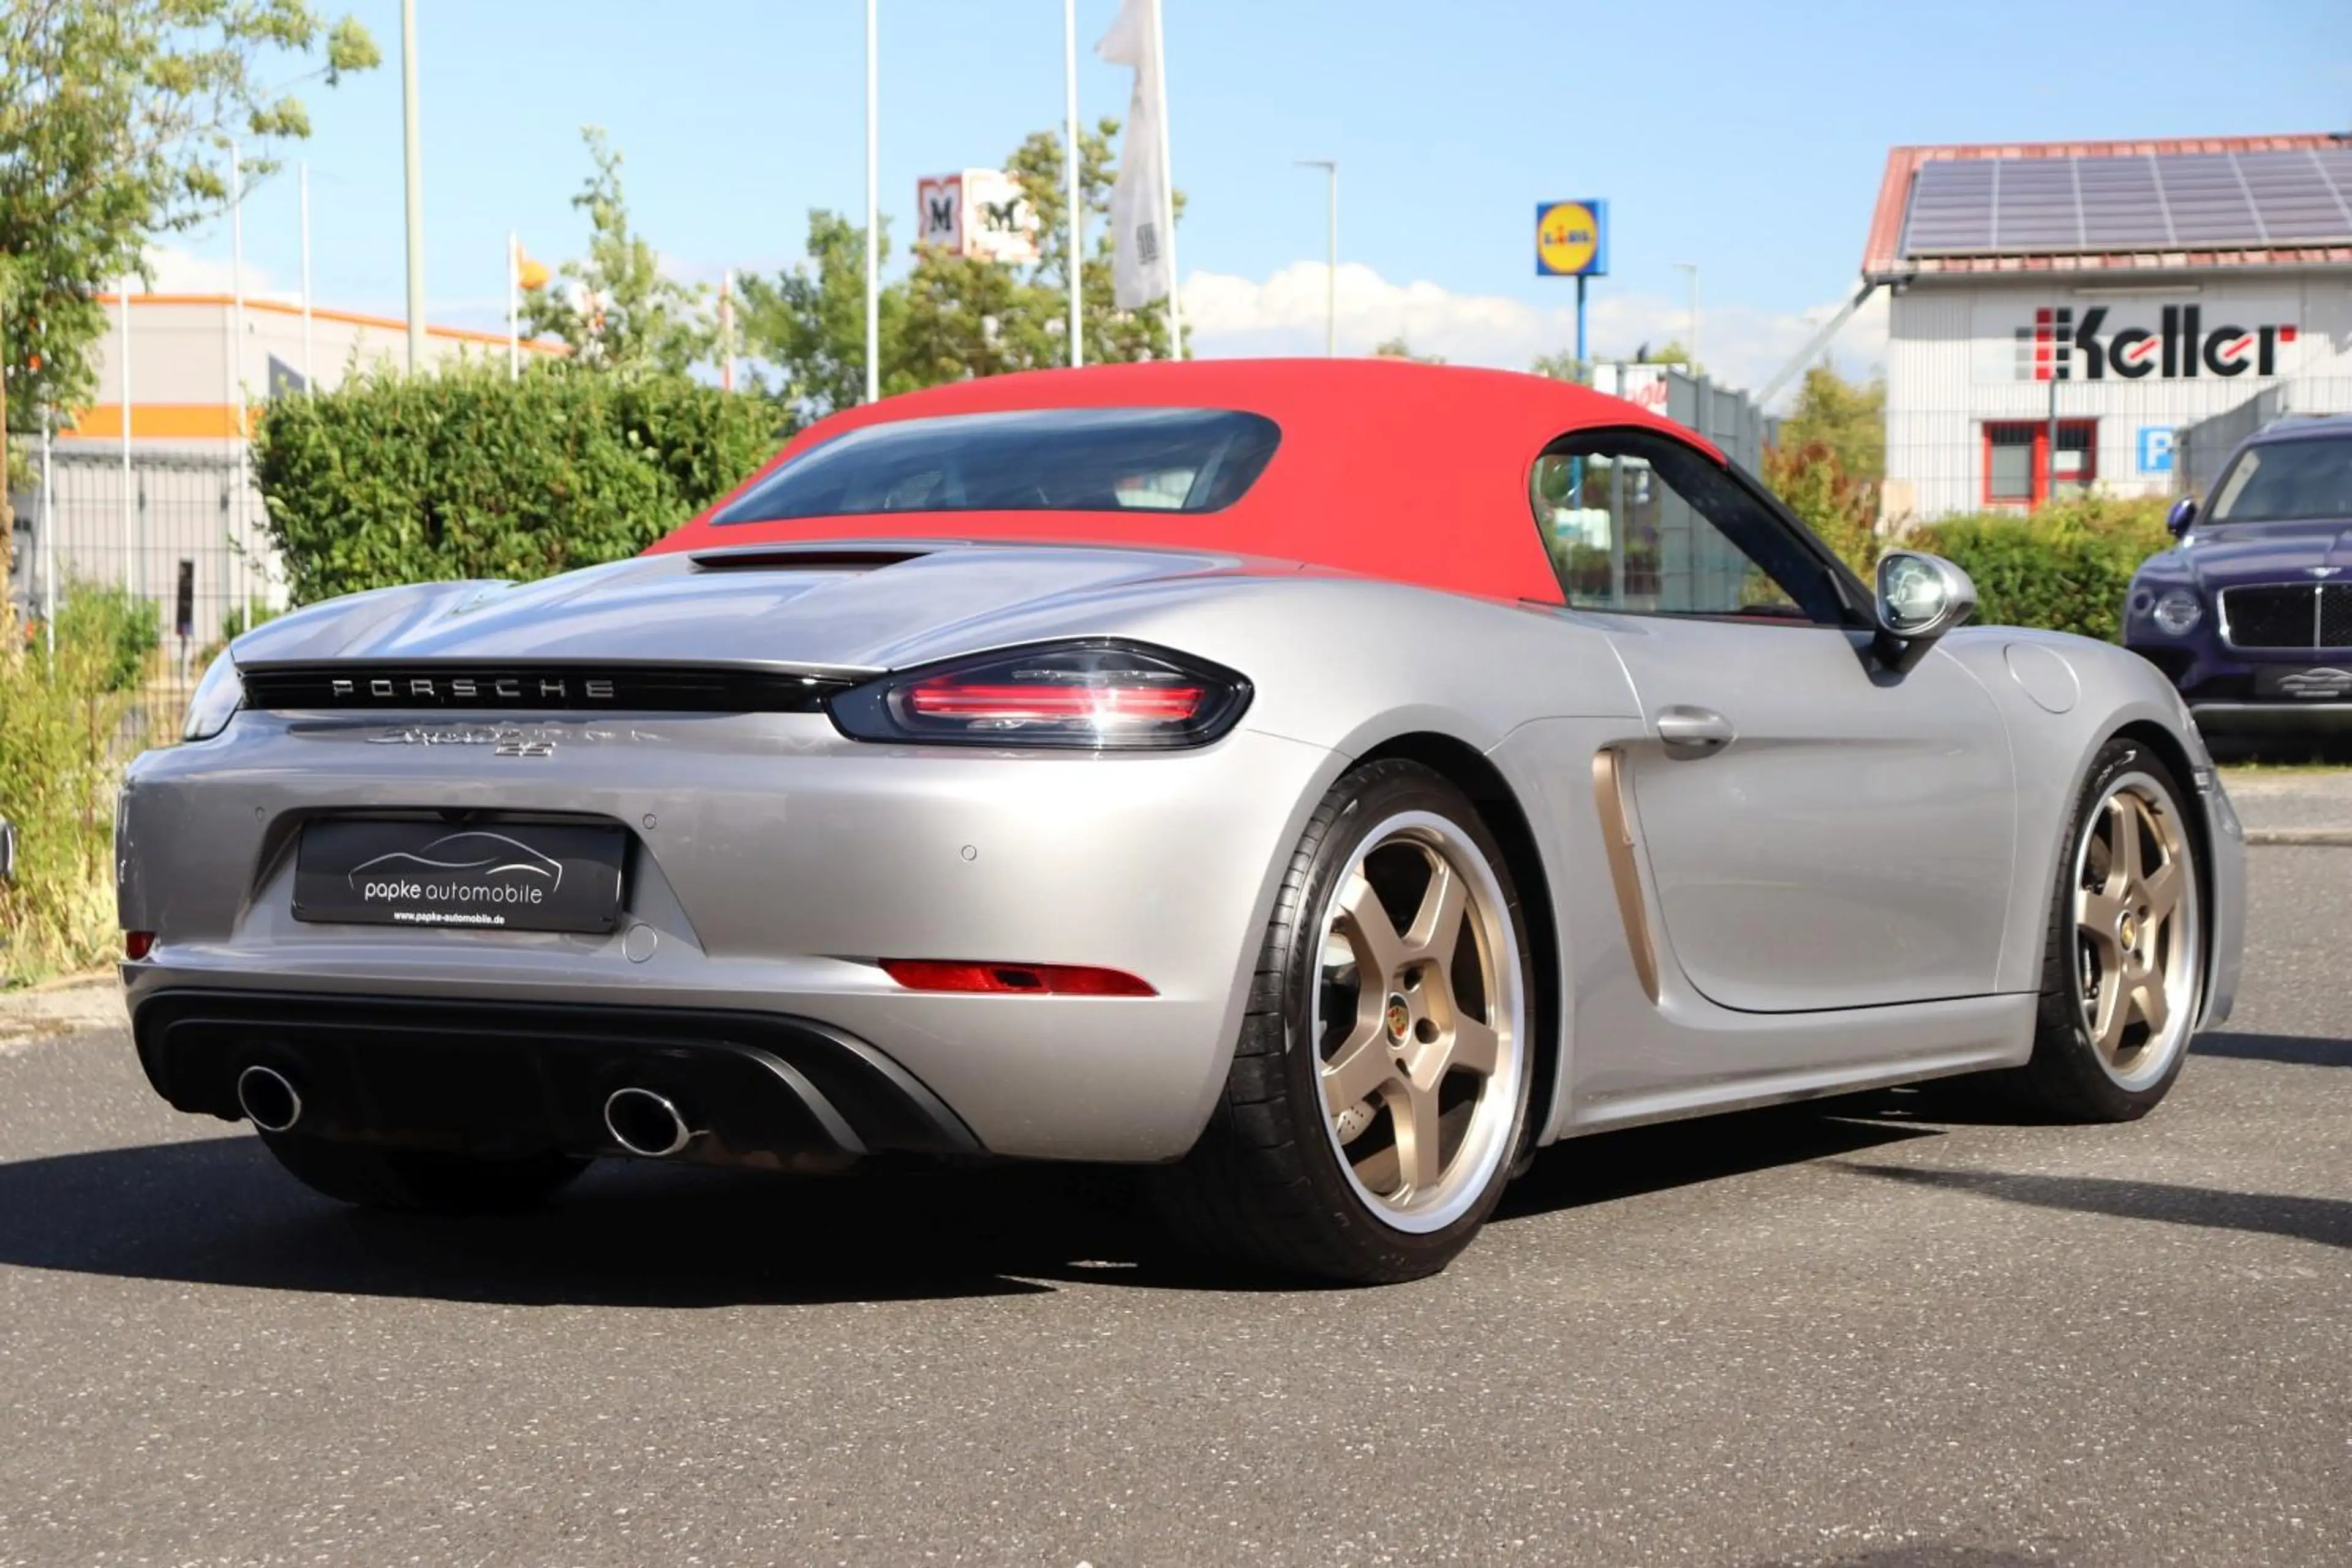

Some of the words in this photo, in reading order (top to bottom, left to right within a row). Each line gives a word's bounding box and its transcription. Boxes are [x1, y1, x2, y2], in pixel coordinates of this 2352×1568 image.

[929, 196, 952, 232] M
[979, 197, 1023, 232] M
[2056, 305, 2296, 379] Keller
[2147, 430, 2173, 469] P
[332, 679, 614, 698] PORSCHE
[364, 879, 421, 901] papke
[426, 881, 543, 904] automobile
[394, 911, 505, 924] www.papke-automobile.de
